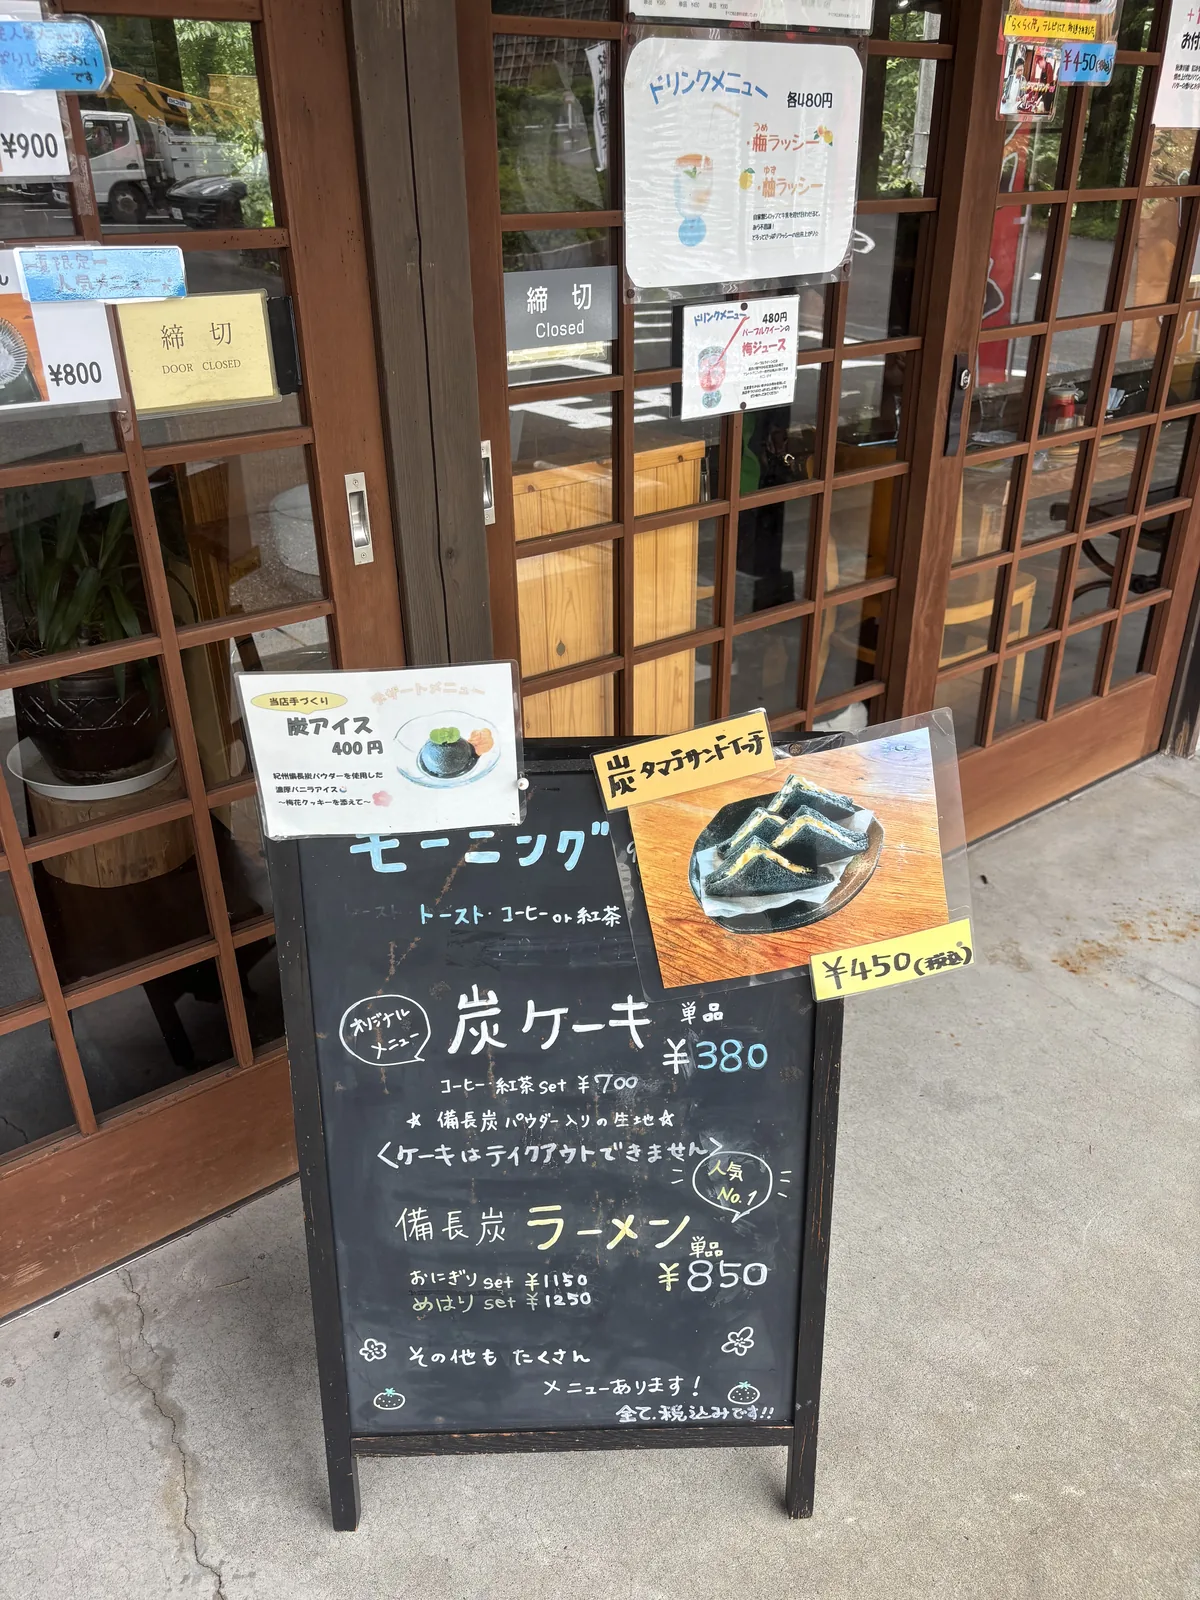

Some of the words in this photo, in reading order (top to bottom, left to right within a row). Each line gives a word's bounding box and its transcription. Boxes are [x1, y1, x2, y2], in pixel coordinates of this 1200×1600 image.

[649, 69, 769, 104] ドリンクメニュー
[787, 91, 833, 109] 各480円
[753, 122, 768, 132] うめ
[0, 132, 59, 159] ¥900
[535, 319, 585, 338] Closed
[694, 310, 747, 326] ドリンクメニュー
[762, 312, 788, 324] 480円
[742, 338, 787, 357] 梅ジュース
[48, 361, 102, 387] ¥800
[162, 362, 194, 375] DOOR
[202, 359, 241, 371] CLOSED
[269, 696, 329, 707] 当店手づくり
[286, 716, 373, 737] 炭アイス
[350, 821, 609, 873] モーニング
[350, 1007, 410, 1036] オリジナル
[447, 983, 652, 1055] 炭ケーキ
[680, 1001, 723, 1025] 単品
[371, 1033, 420, 1060] メニュー
[662, 1038, 768, 1075] ¥380
[578, 1074, 638, 1094] ¥700
[708, 1159, 744, 1182] 人気
[689, 1236, 724, 1258] 単品
[410, 1269, 477, 1287] おにぎり
[483, 1276, 514, 1290] set
[525, 1273, 588, 1292] ¥1150
[658, 1259, 768, 1293] ¥850
[412, 1294, 474, 1313] めはり
[483, 1297, 516, 1310] set
[526, 1292, 592, 1311] ¥1250
